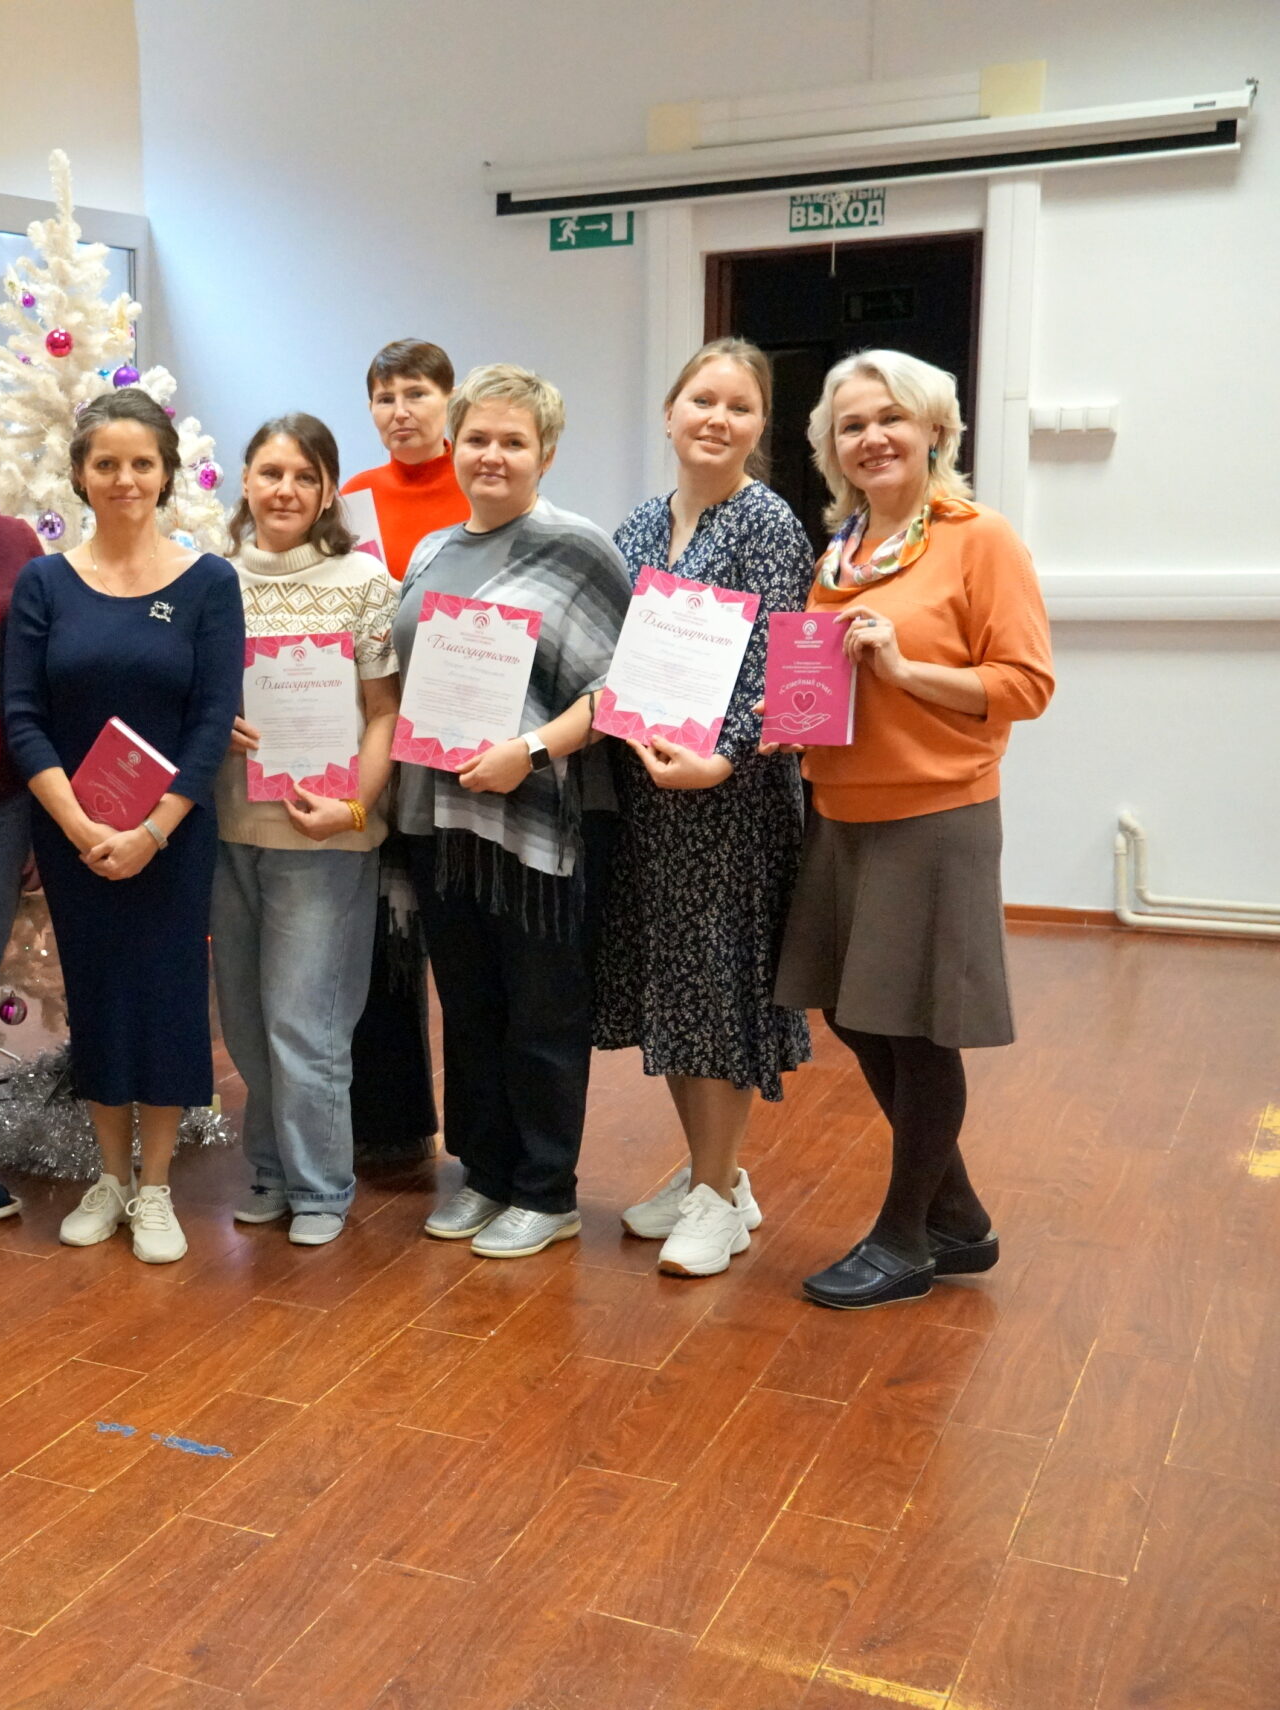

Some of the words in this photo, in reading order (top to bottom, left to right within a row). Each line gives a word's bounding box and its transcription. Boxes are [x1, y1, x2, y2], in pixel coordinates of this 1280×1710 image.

[791, 200, 884, 227] ВЫХОД
[639, 608, 733, 647] Благодарность
[427, 634, 520, 665] Благодарность
[255, 675, 342, 693] Благодарность
